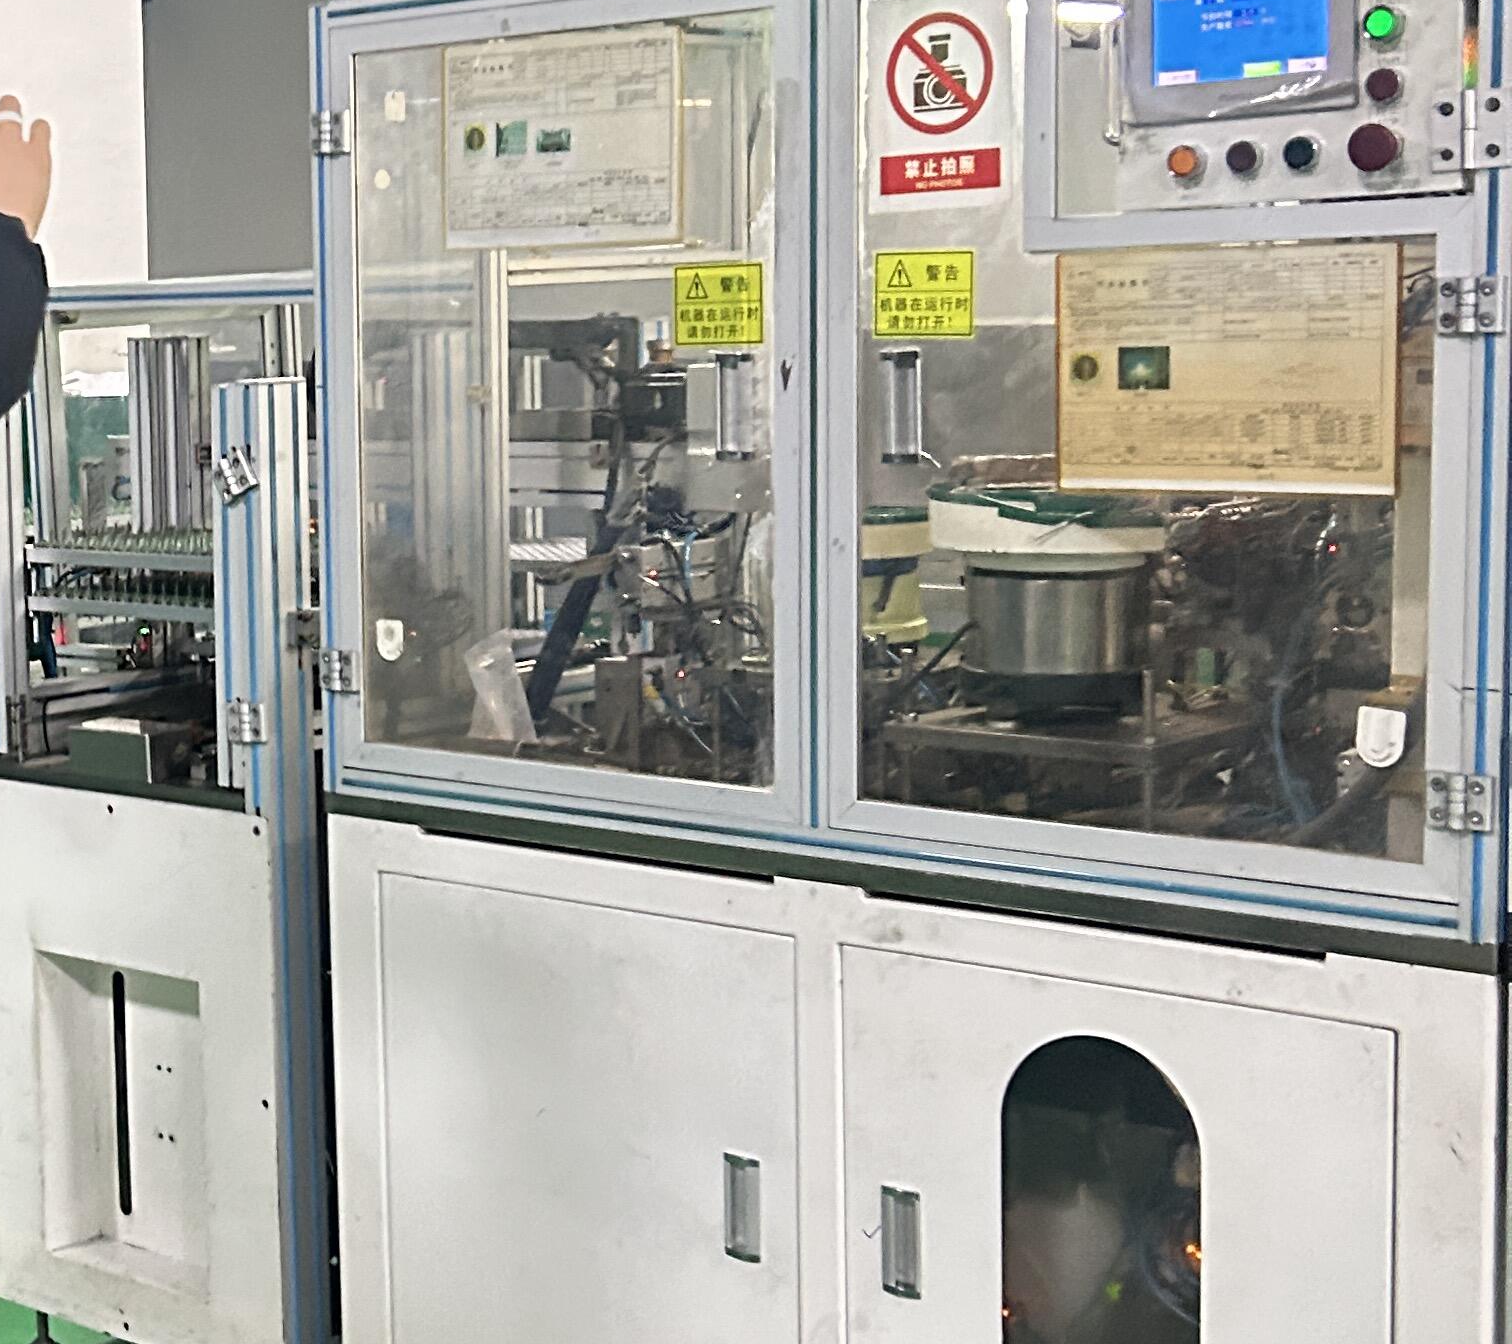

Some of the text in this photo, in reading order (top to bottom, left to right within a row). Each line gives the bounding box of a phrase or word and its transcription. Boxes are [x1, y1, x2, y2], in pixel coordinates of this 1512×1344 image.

[904, 154, 976, 179] 禁止拍照
[926, 264, 959, 282] 警告
[720, 276, 749, 292] 警告
[880, 297, 968, 312] 机器在运行时
[680, 306, 759, 322] 机器在运行时
